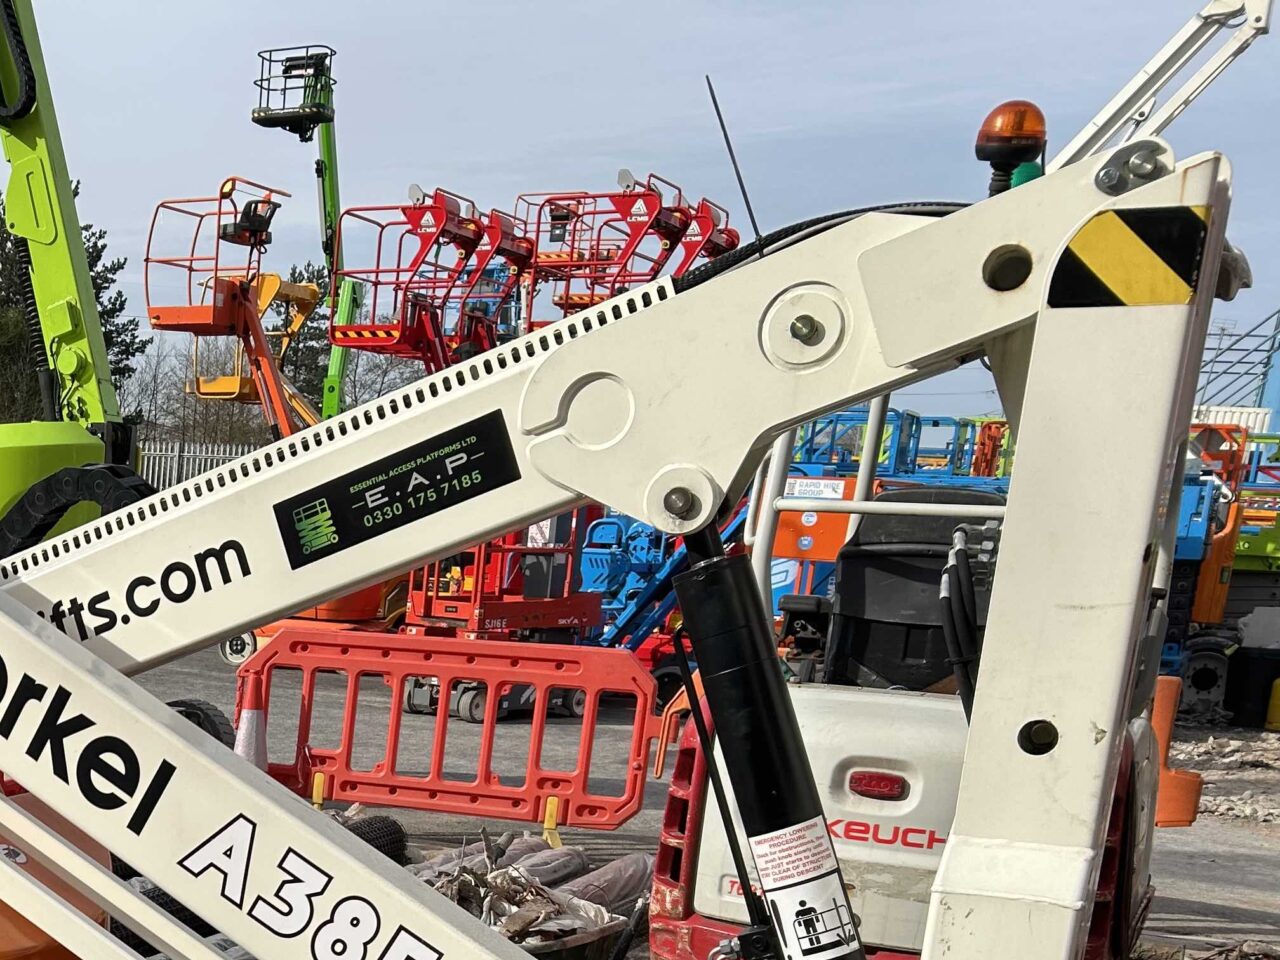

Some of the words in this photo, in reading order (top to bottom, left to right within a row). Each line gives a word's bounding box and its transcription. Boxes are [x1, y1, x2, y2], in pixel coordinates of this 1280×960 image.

[349, 474, 389, 494] ESSENTIAL
[388, 462, 417, 478] ACCESS
[416, 442, 462, 466] PLATFORMS
[461, 435, 477, 448] LTD
[363, 502, 403, 527] 0330
[407, 487, 437, 510] 175
[440, 470, 482, 497] 7185
[768, 833, 807, 849] PROCEDURE
[771, 867, 791, 876] CLEAR
[796, 863, 824, 877] DESCENT
